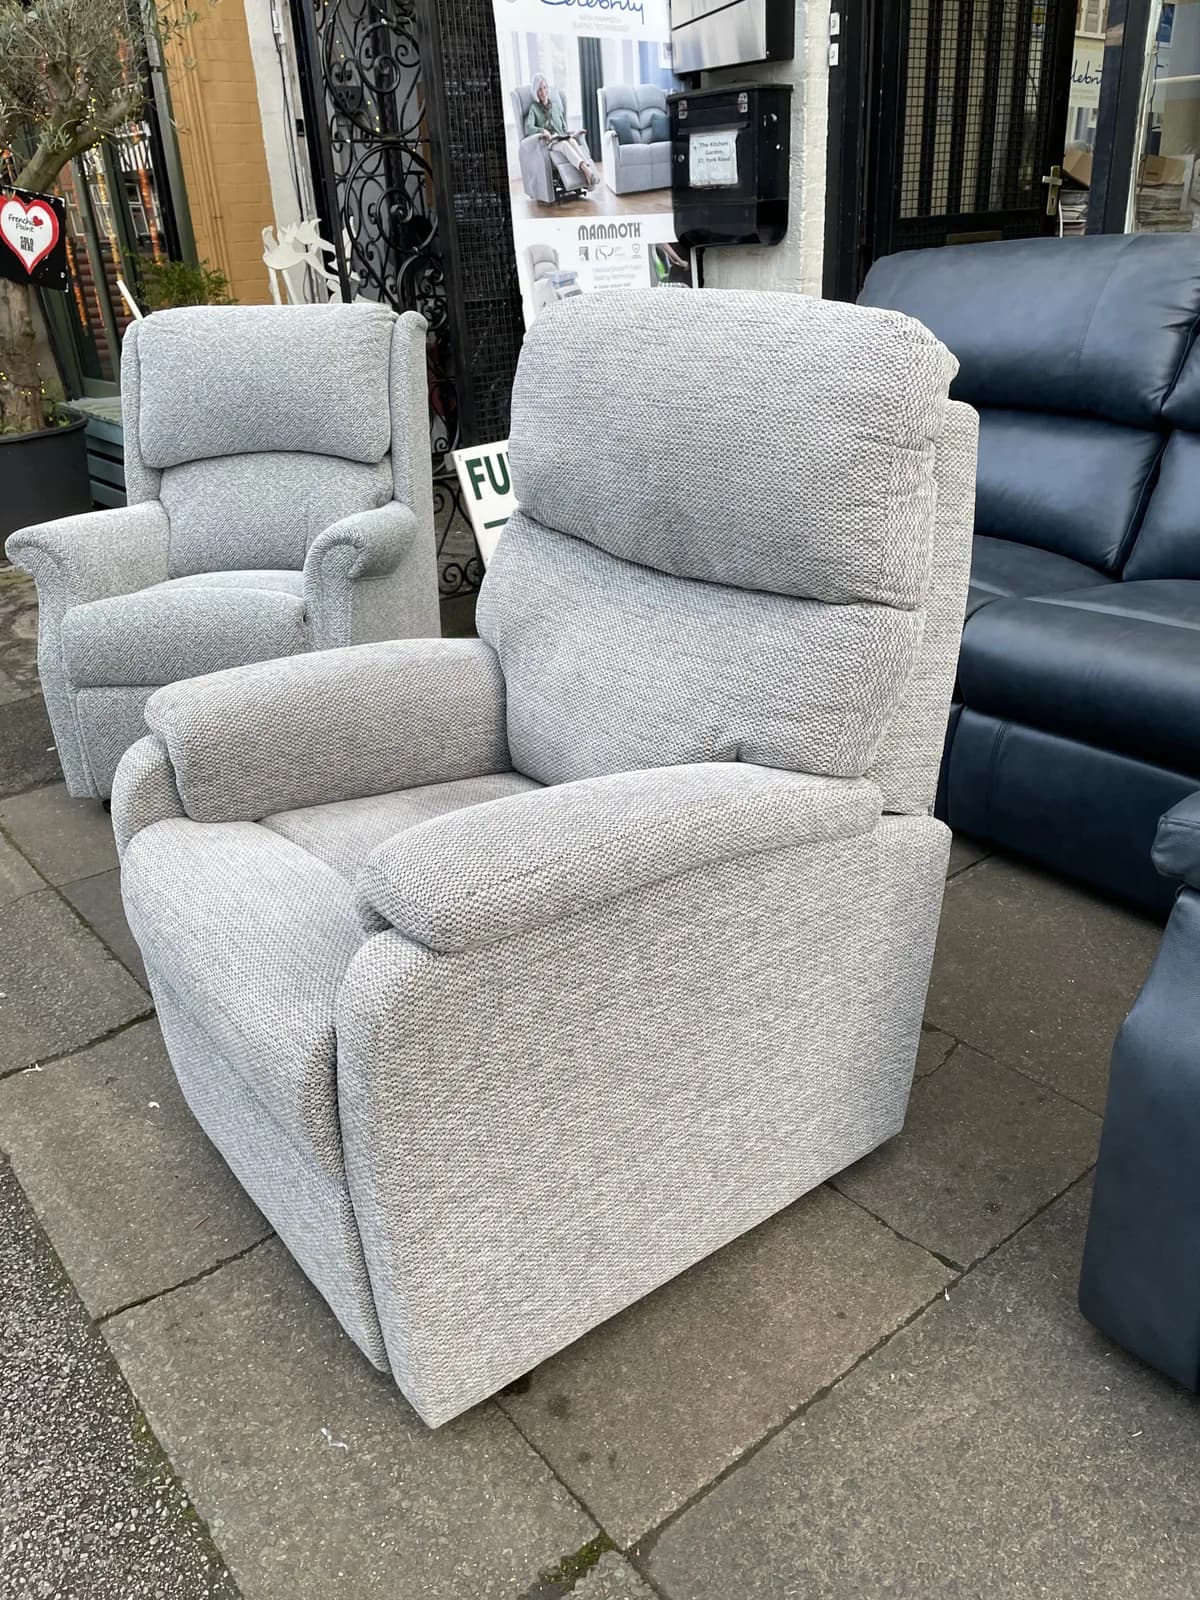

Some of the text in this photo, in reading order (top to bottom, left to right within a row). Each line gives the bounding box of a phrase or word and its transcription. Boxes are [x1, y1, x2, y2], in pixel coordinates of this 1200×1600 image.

[540, 0, 645, 24] eebrity
[578, 222, 641, 241] MAMMOTH
[465, 452, 510, 501] FU
